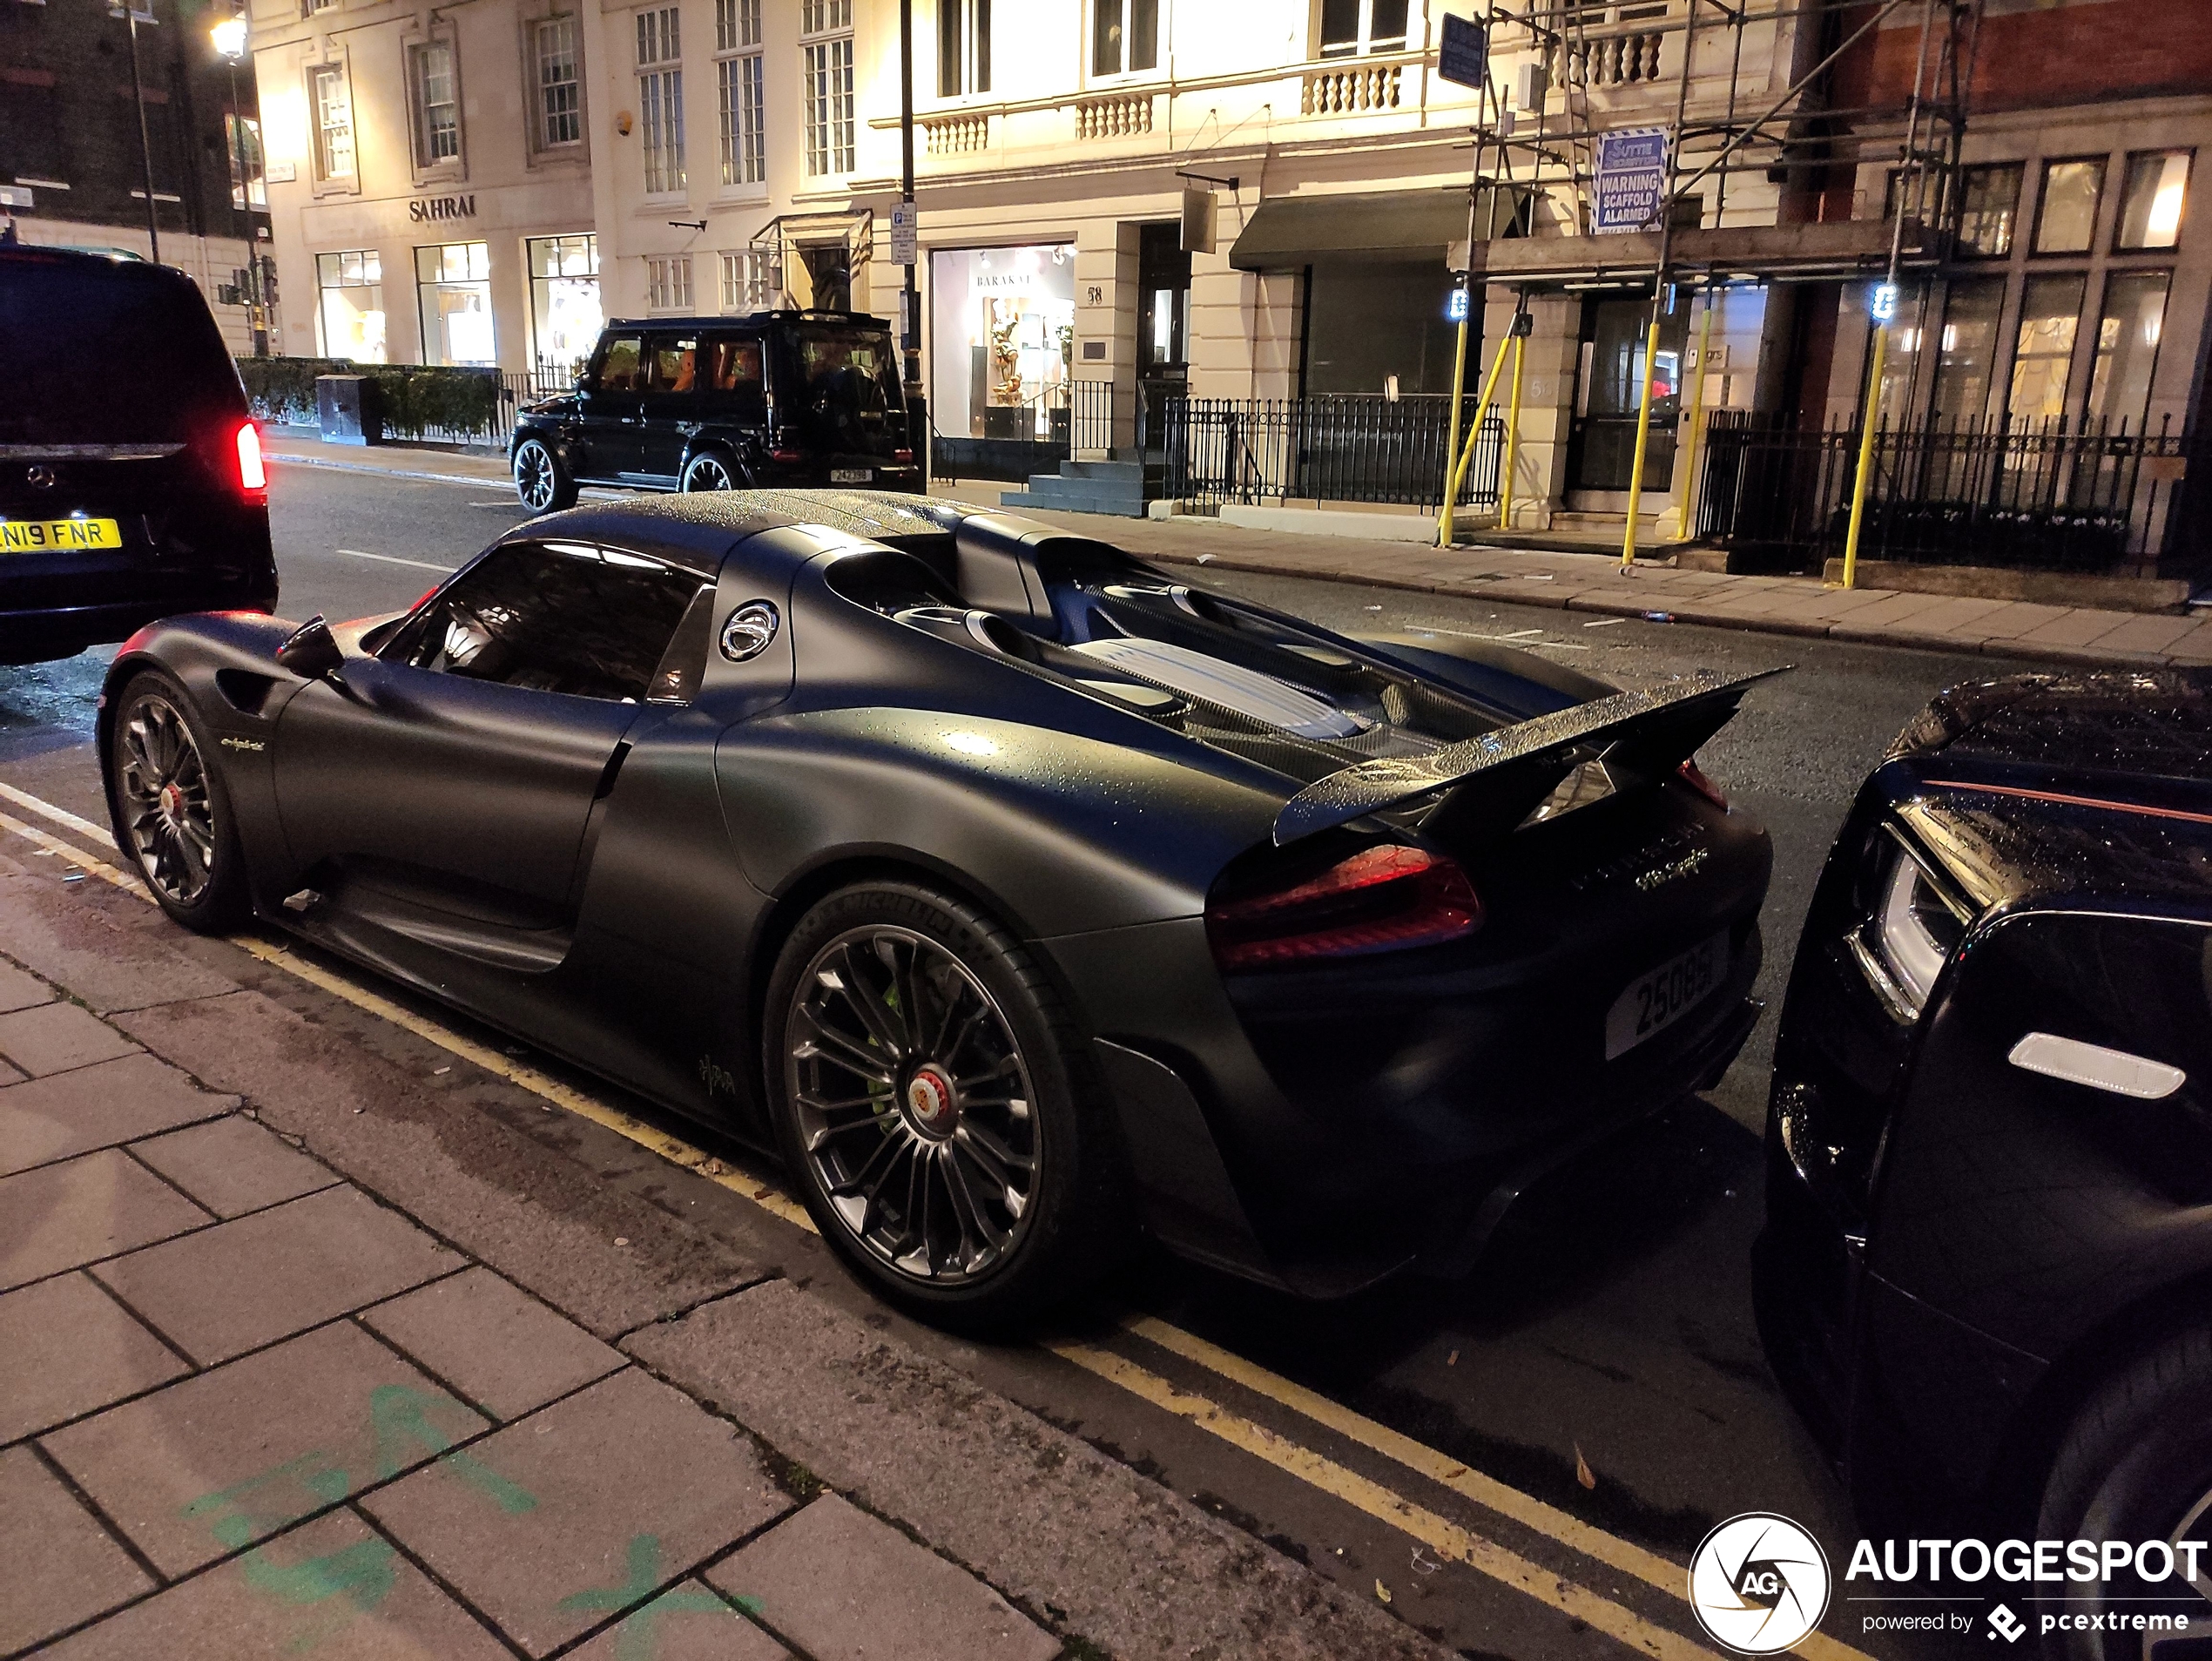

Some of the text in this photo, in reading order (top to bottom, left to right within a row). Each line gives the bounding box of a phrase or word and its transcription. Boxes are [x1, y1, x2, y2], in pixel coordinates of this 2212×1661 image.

[1602, 173, 1658, 193] WARNING
[409, 194, 476, 222] SAHRAI
[1603, 192, 1653, 208] SCAFFOLD
[1604, 207, 1650, 223] ALARMED
[1088, 286, 1103, 304] 58
[0, 523, 104, 547] N19 FNR
